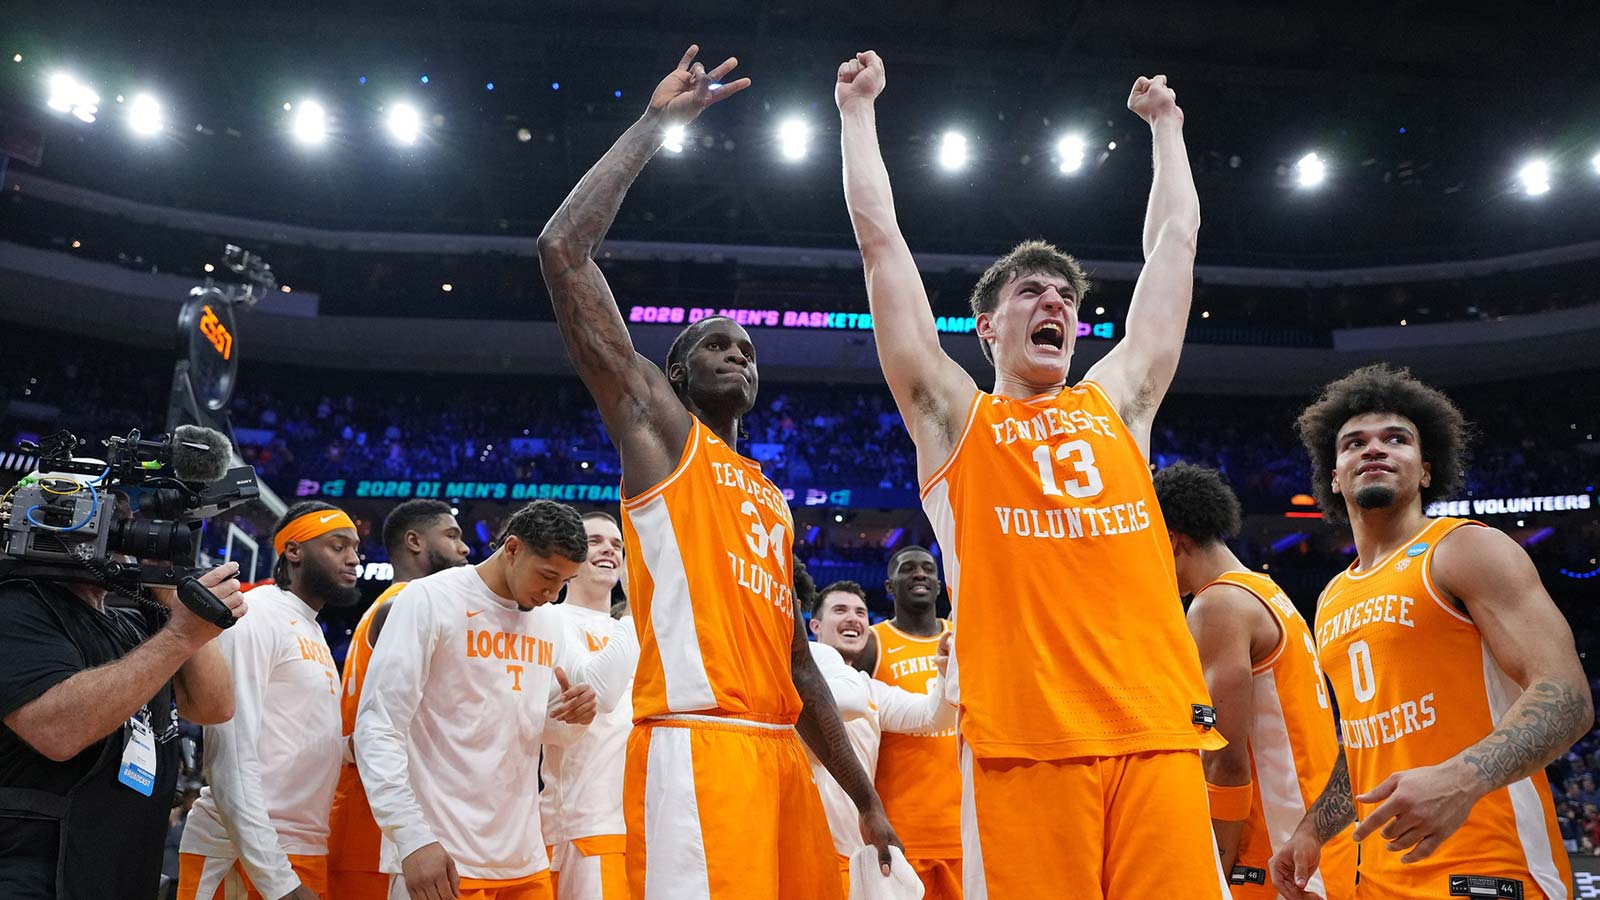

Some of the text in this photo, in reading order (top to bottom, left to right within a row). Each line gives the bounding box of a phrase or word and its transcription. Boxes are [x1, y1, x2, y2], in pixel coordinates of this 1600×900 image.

[629, 306, 685, 323] 2026
[718, 309, 780, 326] MEN'S
[783, 311, 874, 329] BASKETB
[991, 408, 1117, 445] TENNESSEE
[1032, 439, 1104, 499] 13
[357, 481, 411, 497] 2026
[416, 482, 441, 498] DI
[446, 483, 506, 499] MEN'S
[1473, 494, 1591, 514] VOLUNTEERS
[994, 500, 1150, 539] VOLUNTEERS
[741, 501, 786, 580] 34
[1316, 595, 1415, 656] TENNESSEE
[466, 630, 554, 668] LOCK IT IN
[506, 665, 523, 691] T
[1348, 640, 1376, 703] 0
[1501, 884, 1513, 893] 44
